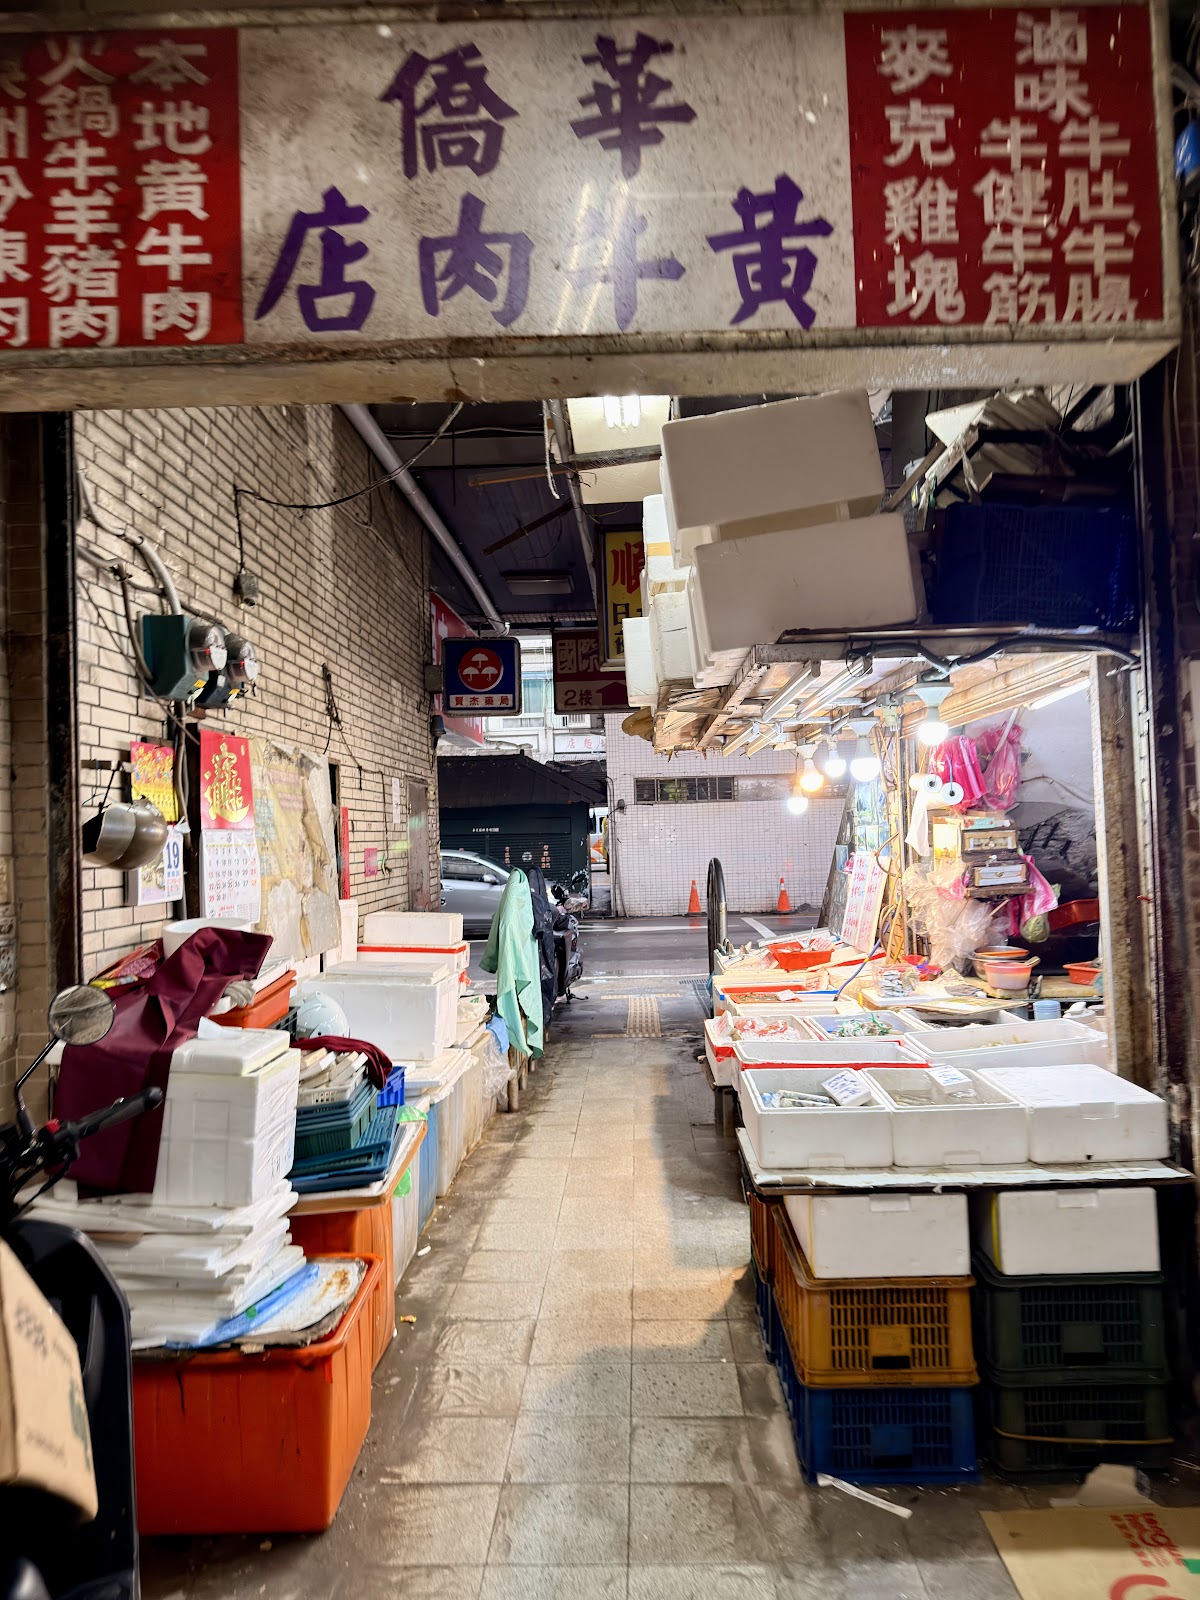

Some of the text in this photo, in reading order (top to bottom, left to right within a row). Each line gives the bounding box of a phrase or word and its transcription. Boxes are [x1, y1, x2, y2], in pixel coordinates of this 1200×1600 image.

[380, 31, 697, 180] 華僑
[1014, 11, 1093, 123] 滷味
[128, 39, 213, 342] 本地黃牛肉
[877, 25, 966, 325] 麥克雞塊
[254, 173, 833, 333] 黃牛肉店
[166, 842, 180, 869] 19
